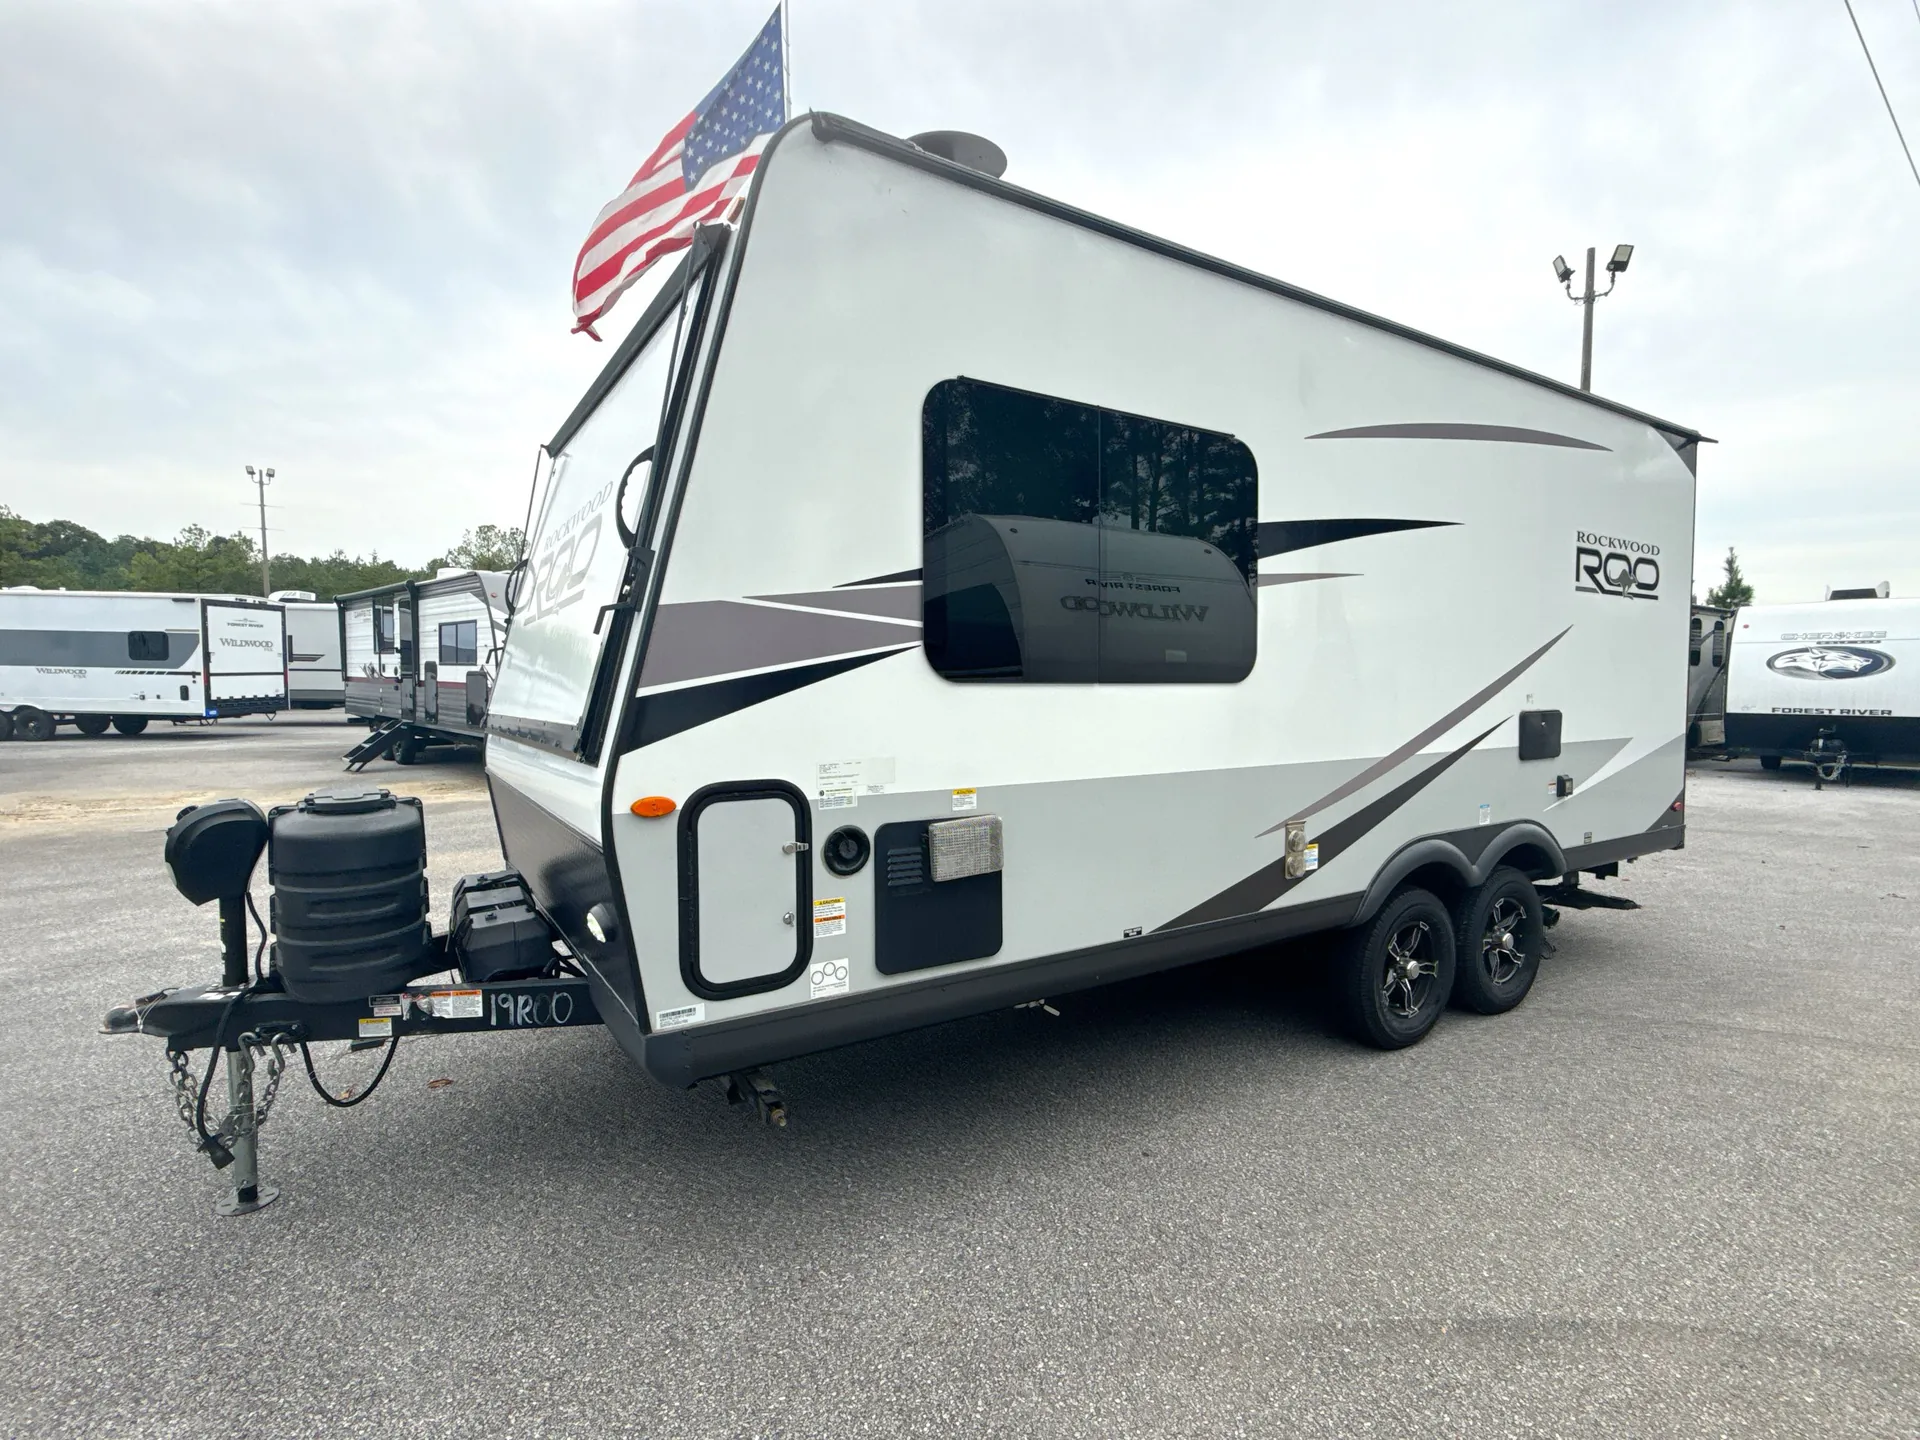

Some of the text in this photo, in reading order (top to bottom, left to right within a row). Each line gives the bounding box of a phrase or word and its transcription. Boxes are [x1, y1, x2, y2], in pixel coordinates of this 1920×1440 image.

[544, 480, 614, 552] ROCKWOOD
[1576, 531, 1660, 556] ROCKWOOD
[1575, 546, 1660, 597] ROO
[219, 637, 274, 648] WILDWOOD
[36, 667, 87, 675] WILDWOOD
[1771, 707, 1892, 716] FOREST RIVER
